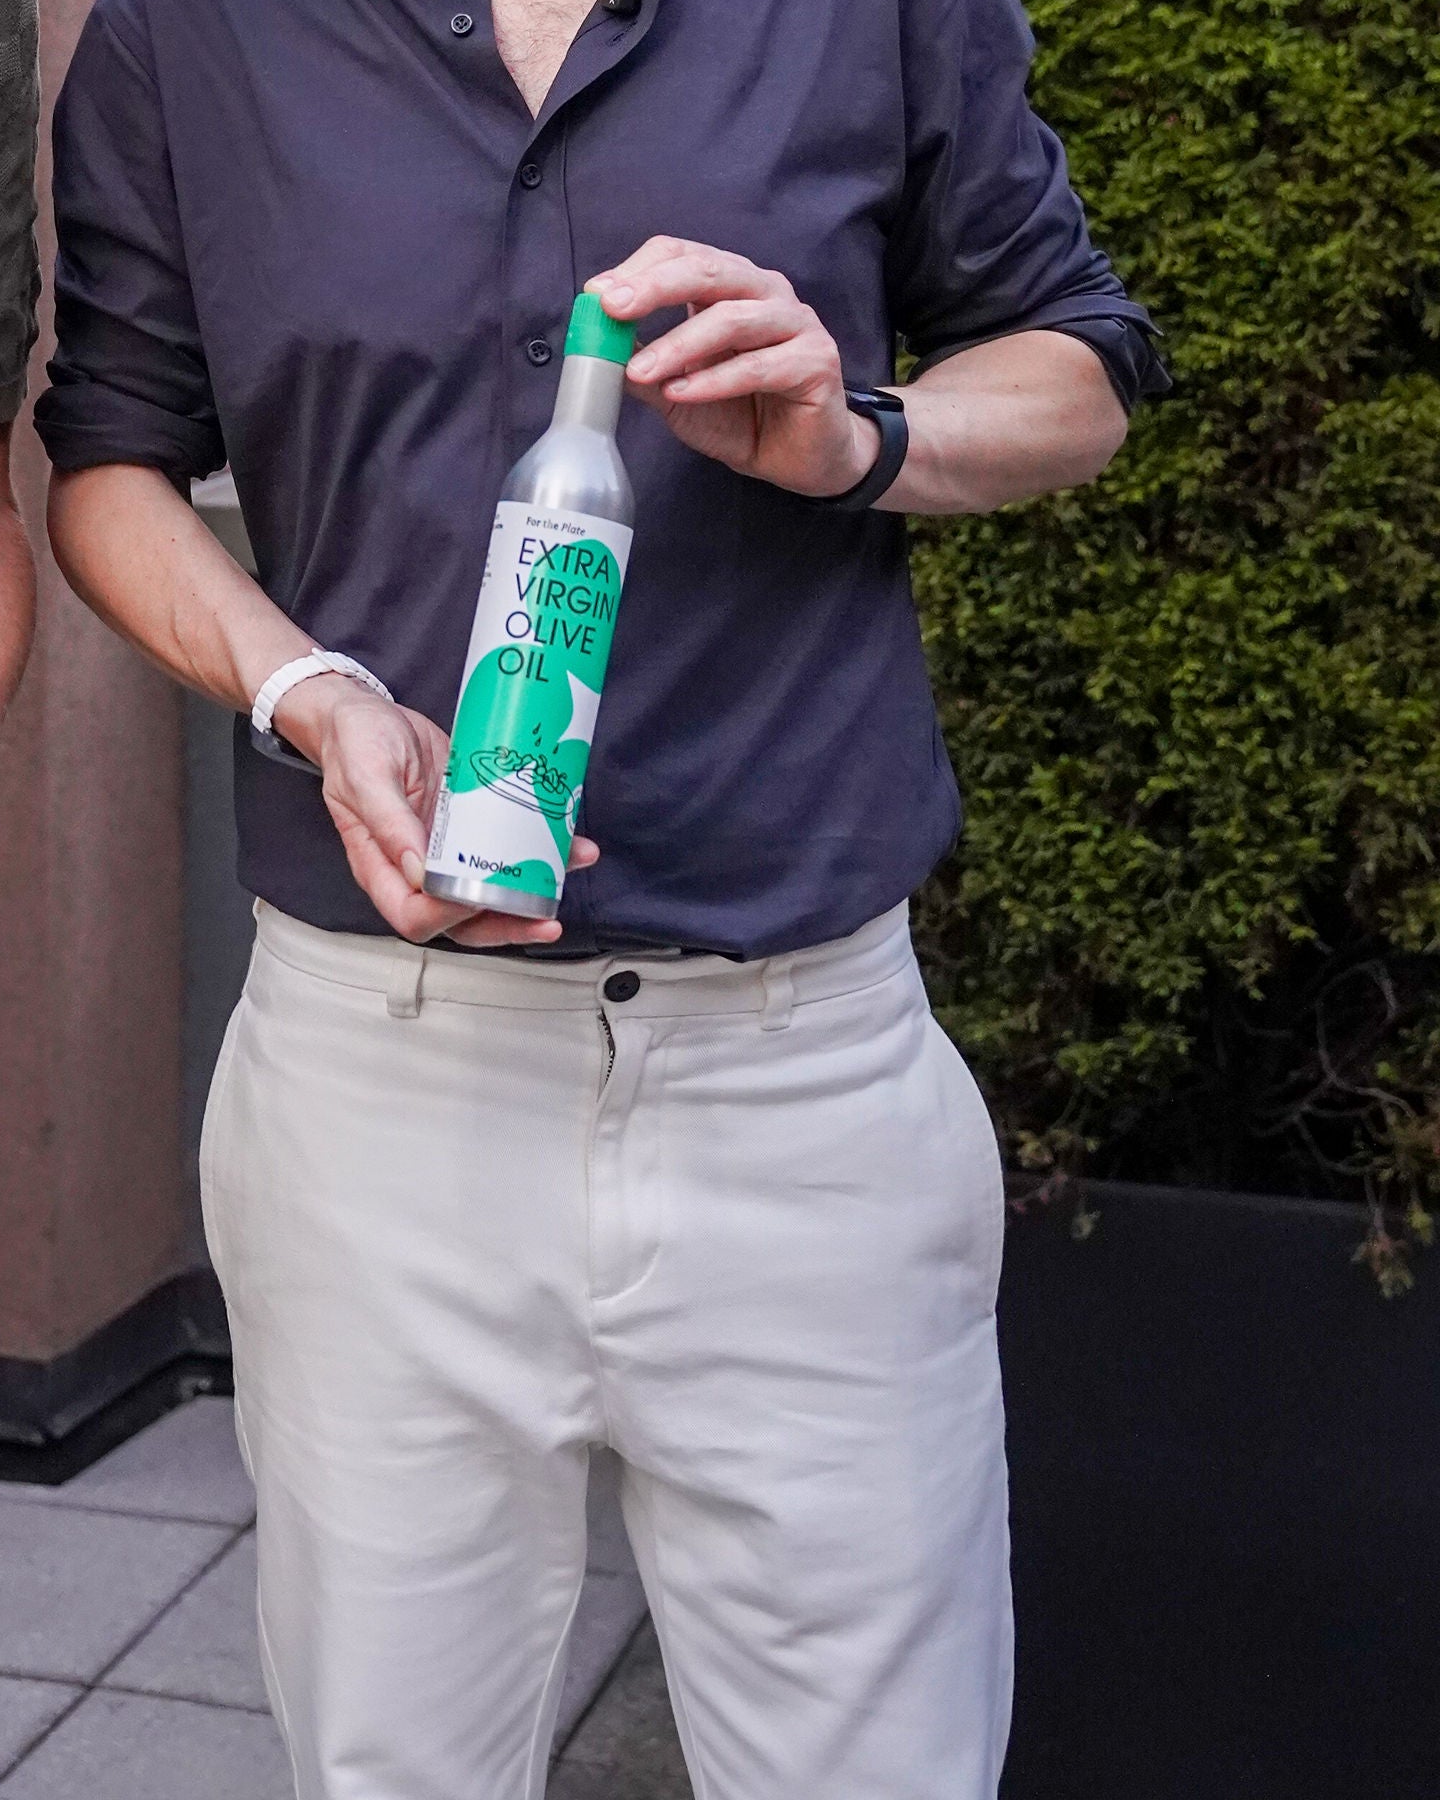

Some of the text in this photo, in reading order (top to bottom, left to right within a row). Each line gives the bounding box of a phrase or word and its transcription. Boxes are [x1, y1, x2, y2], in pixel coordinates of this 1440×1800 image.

[526, 516, 586, 537] For the Plate
[518, 537, 611, 584] EXTRA
[515, 573, 616, 624] VIRGIN
[505, 610, 597, 655] OLIVE
[497, 647, 549, 683] OIL
[469, 855, 522, 878] Neolea
